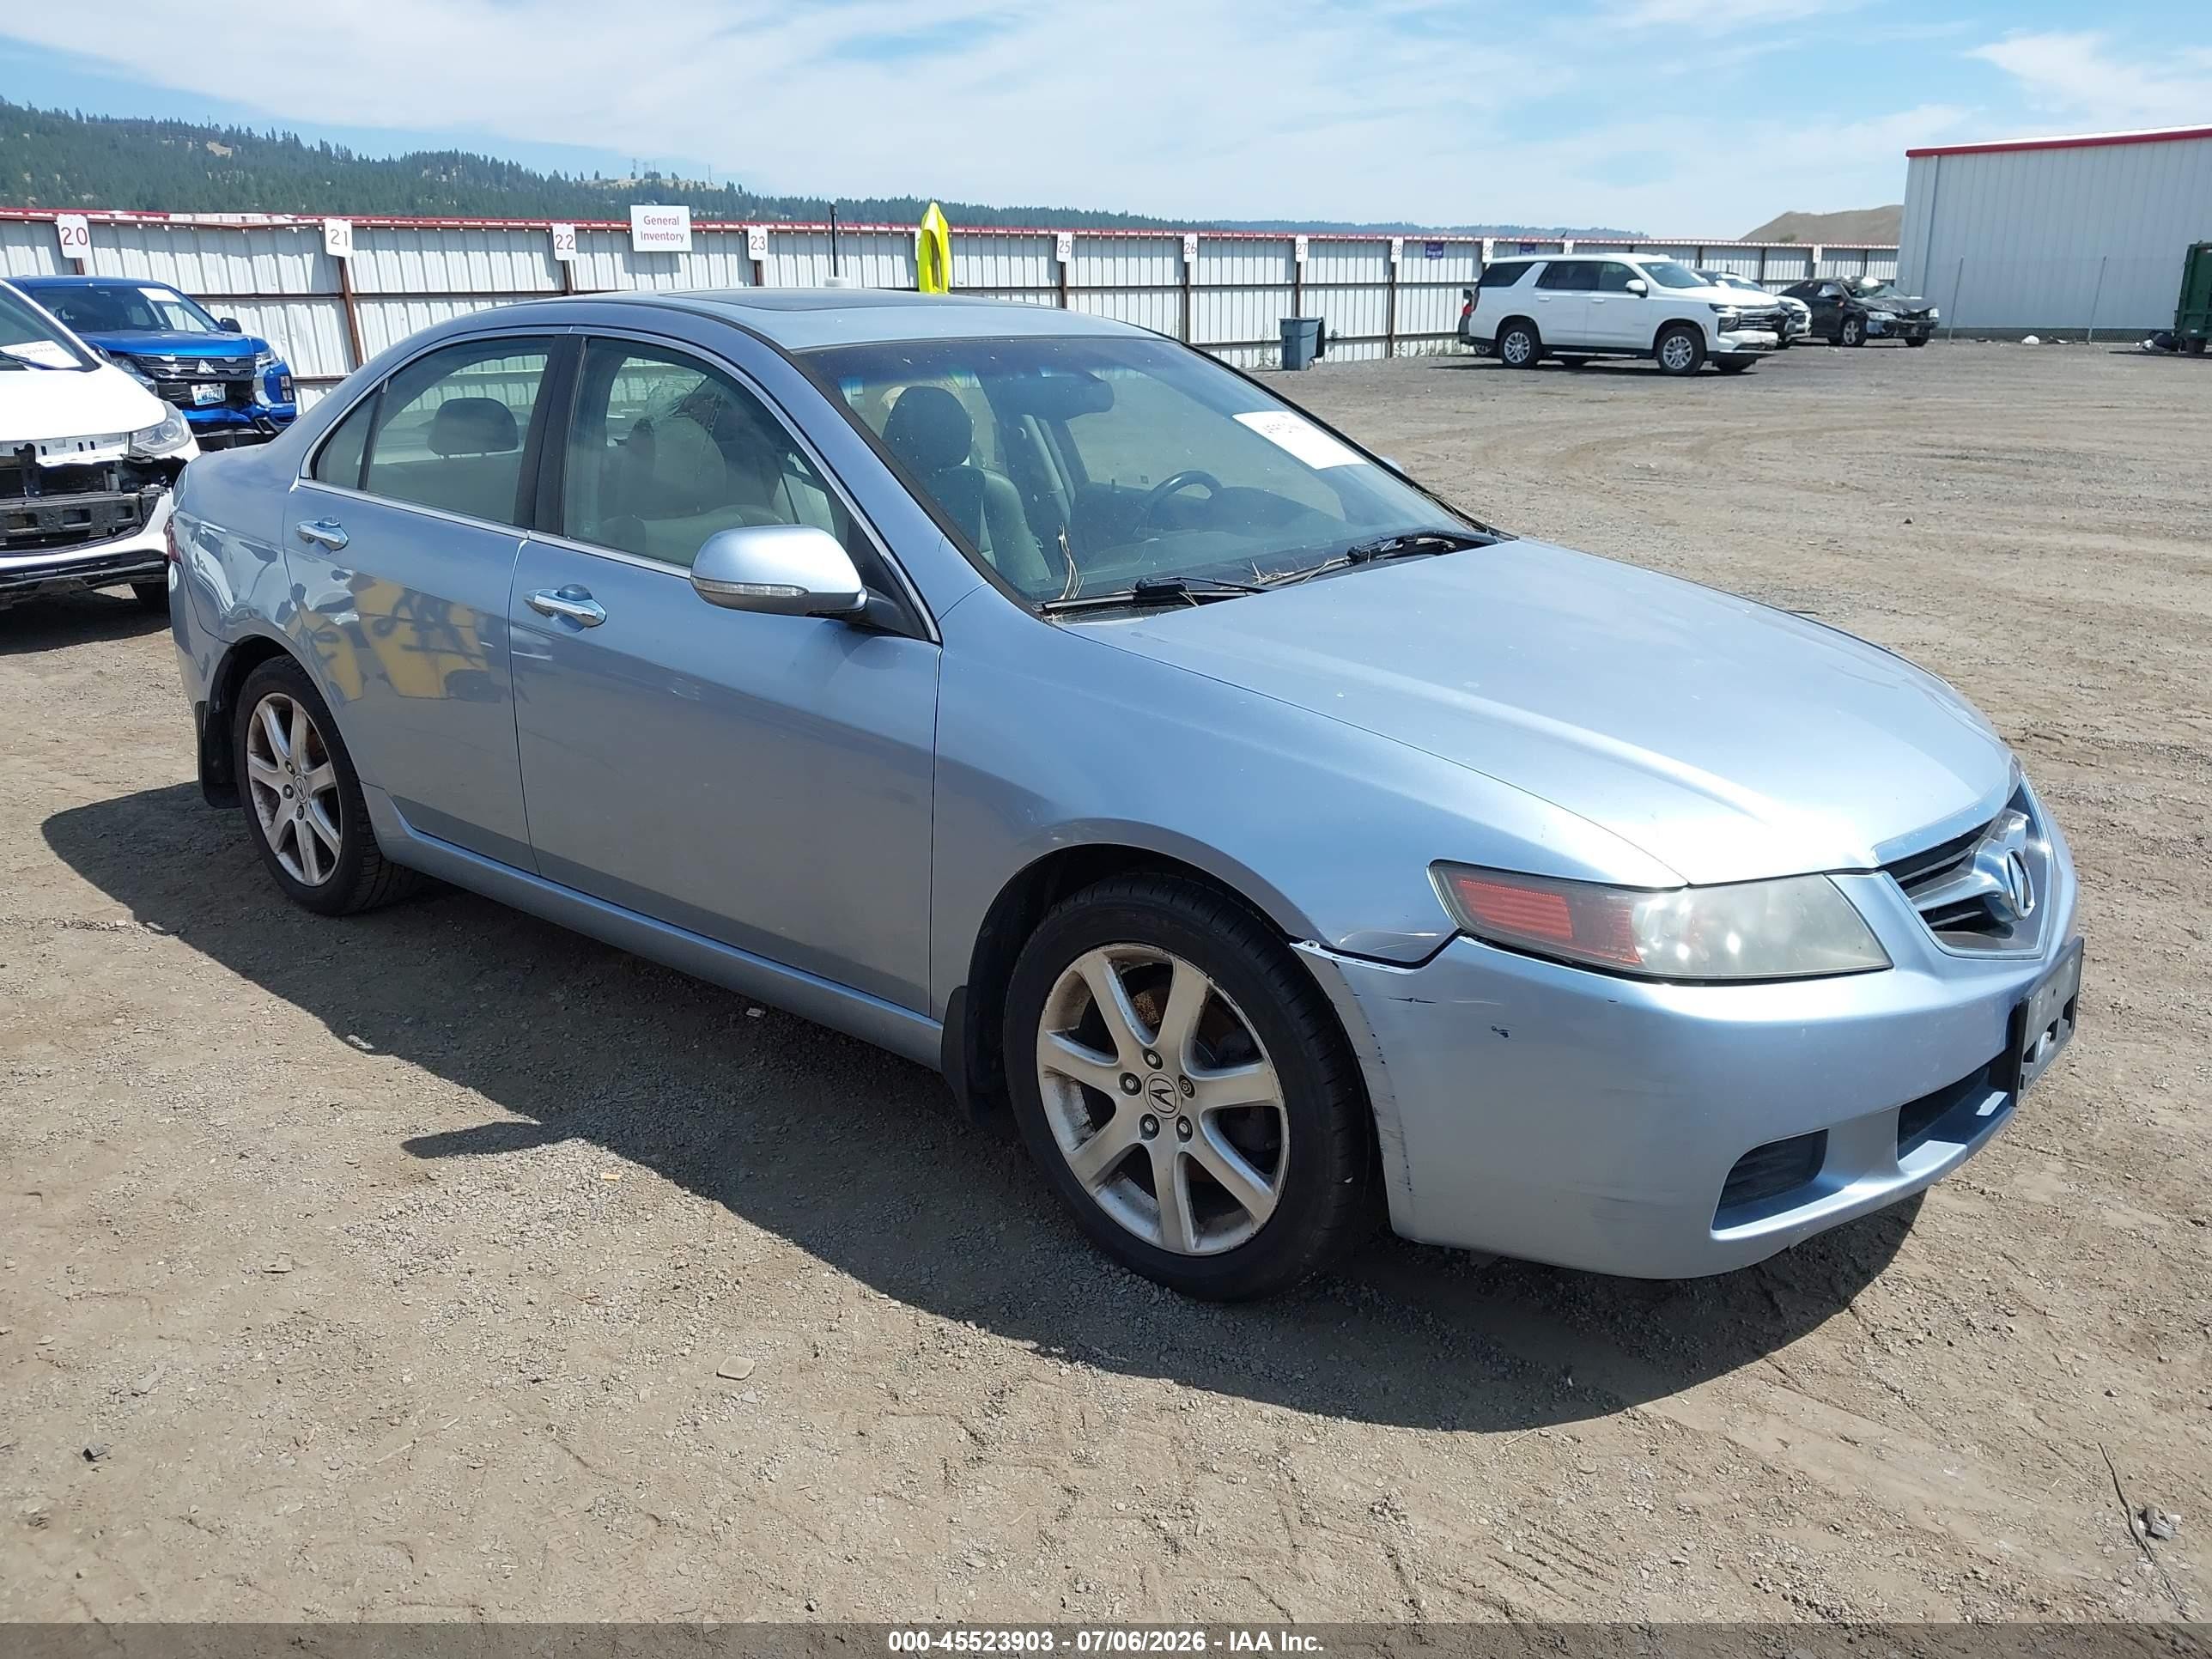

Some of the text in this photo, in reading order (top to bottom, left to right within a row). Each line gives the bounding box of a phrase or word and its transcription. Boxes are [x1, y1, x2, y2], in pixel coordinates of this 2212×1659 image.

[643, 215, 680, 226] General
[61, 227, 88, 246] 20
[330, 228, 348, 246] 21
[556, 234, 574, 250] 22
[641, 231, 685, 244] Inventory
[750, 235, 766, 250] 23
[1059, 240, 1071, 253] 25
[1184, 241, 1197, 254] 26
[1296, 242, 1307, 255] 27
